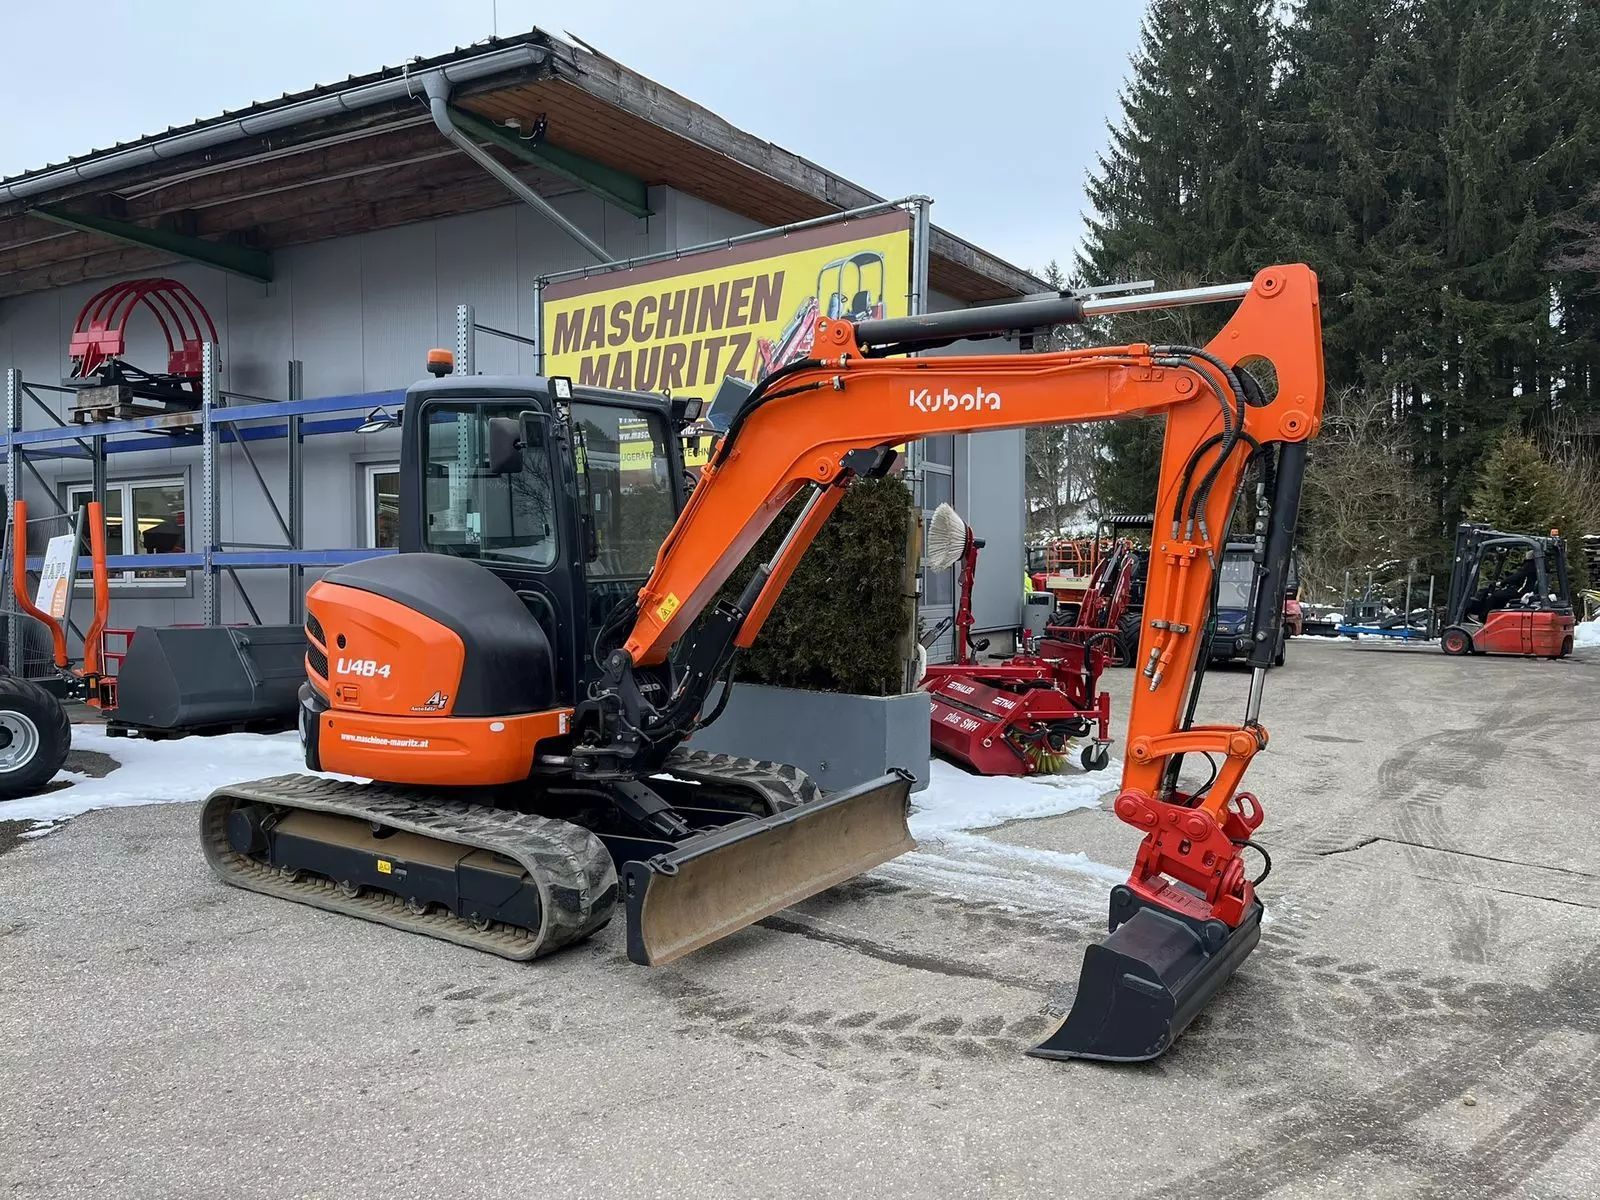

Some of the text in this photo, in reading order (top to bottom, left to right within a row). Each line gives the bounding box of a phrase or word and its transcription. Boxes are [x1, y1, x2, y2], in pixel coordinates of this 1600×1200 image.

[552, 271, 785, 355] MASCHINEN
[578, 332, 752, 391] MAURITZ
[909, 387, 1001, 412] Kubota
[337, 658, 391, 678] U48-4
[943, 712, 981, 732] plus SWH
[341, 733, 428, 747] www.maschinen-mauritz.at
